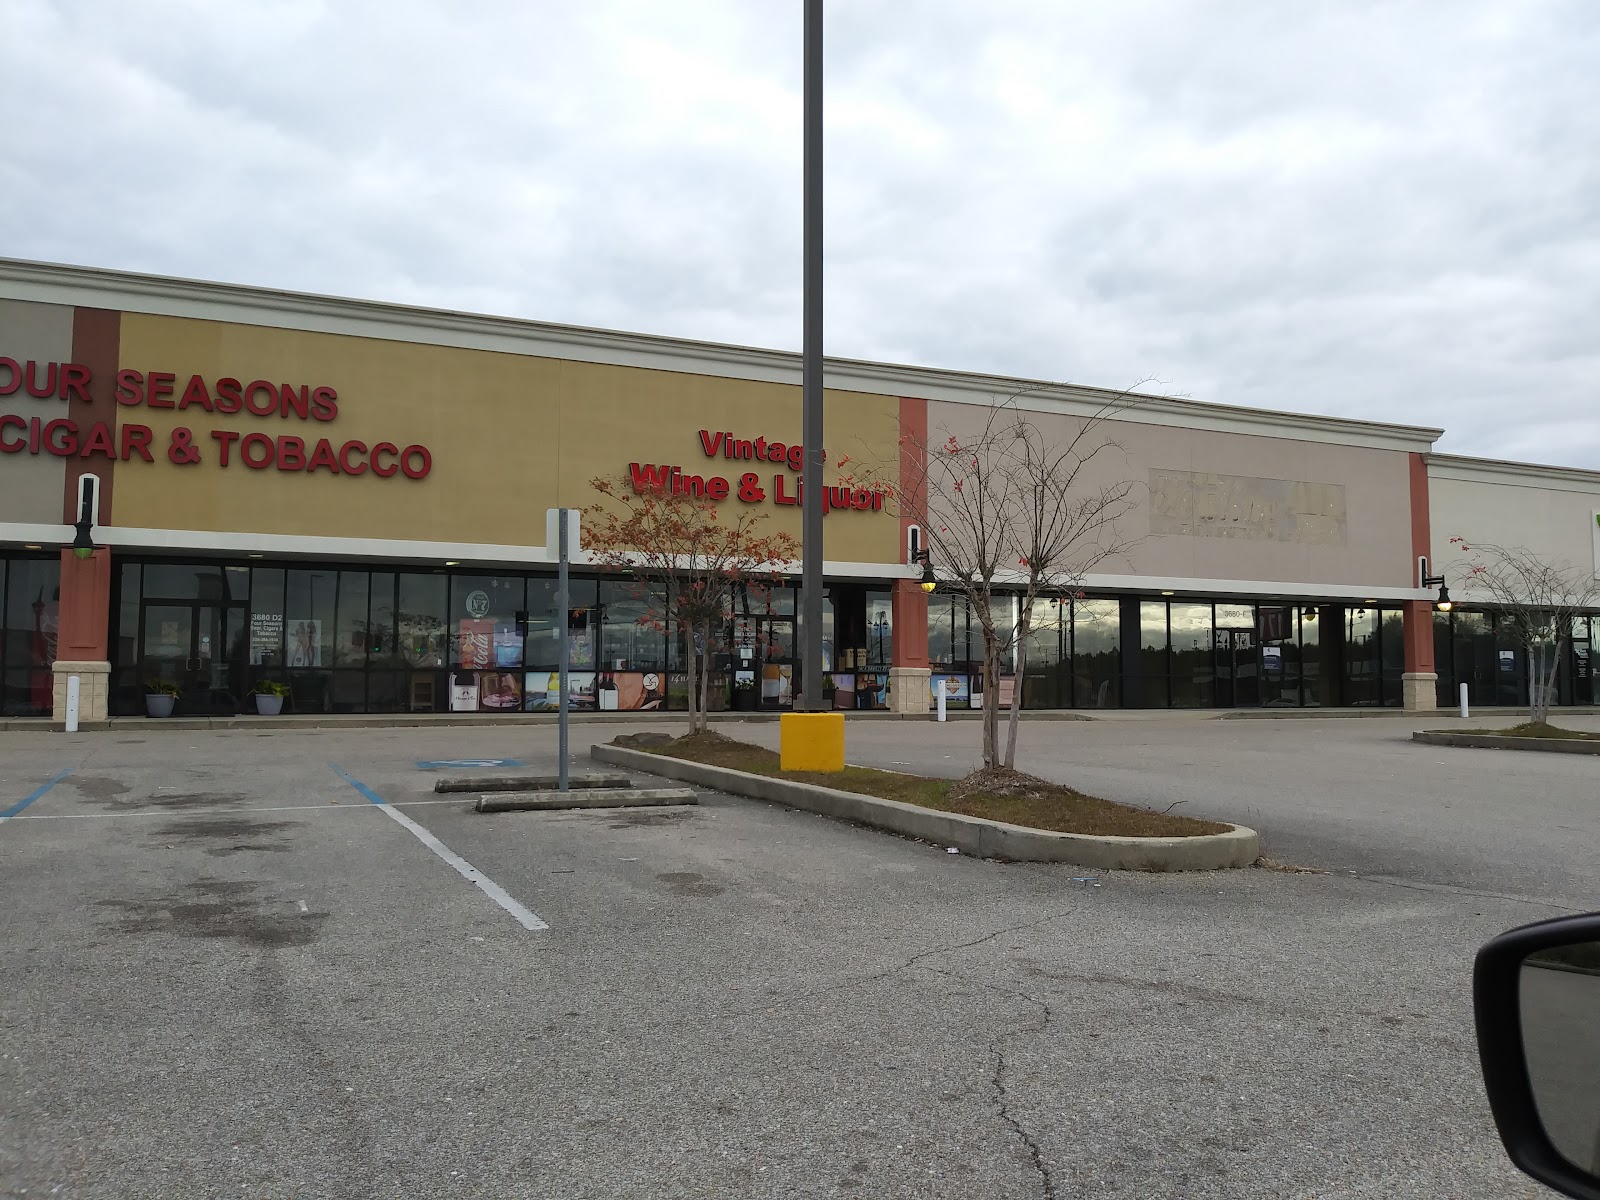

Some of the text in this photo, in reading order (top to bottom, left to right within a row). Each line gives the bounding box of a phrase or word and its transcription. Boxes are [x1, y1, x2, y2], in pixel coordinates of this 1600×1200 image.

[115, 368, 339, 422] SEASONS
[0, 414, 433, 480] CIGAR & TOBACCO
[698, 429, 827, 472] Vintag
[629, 462, 730, 501] Wine
[737, 472, 766, 503] &
